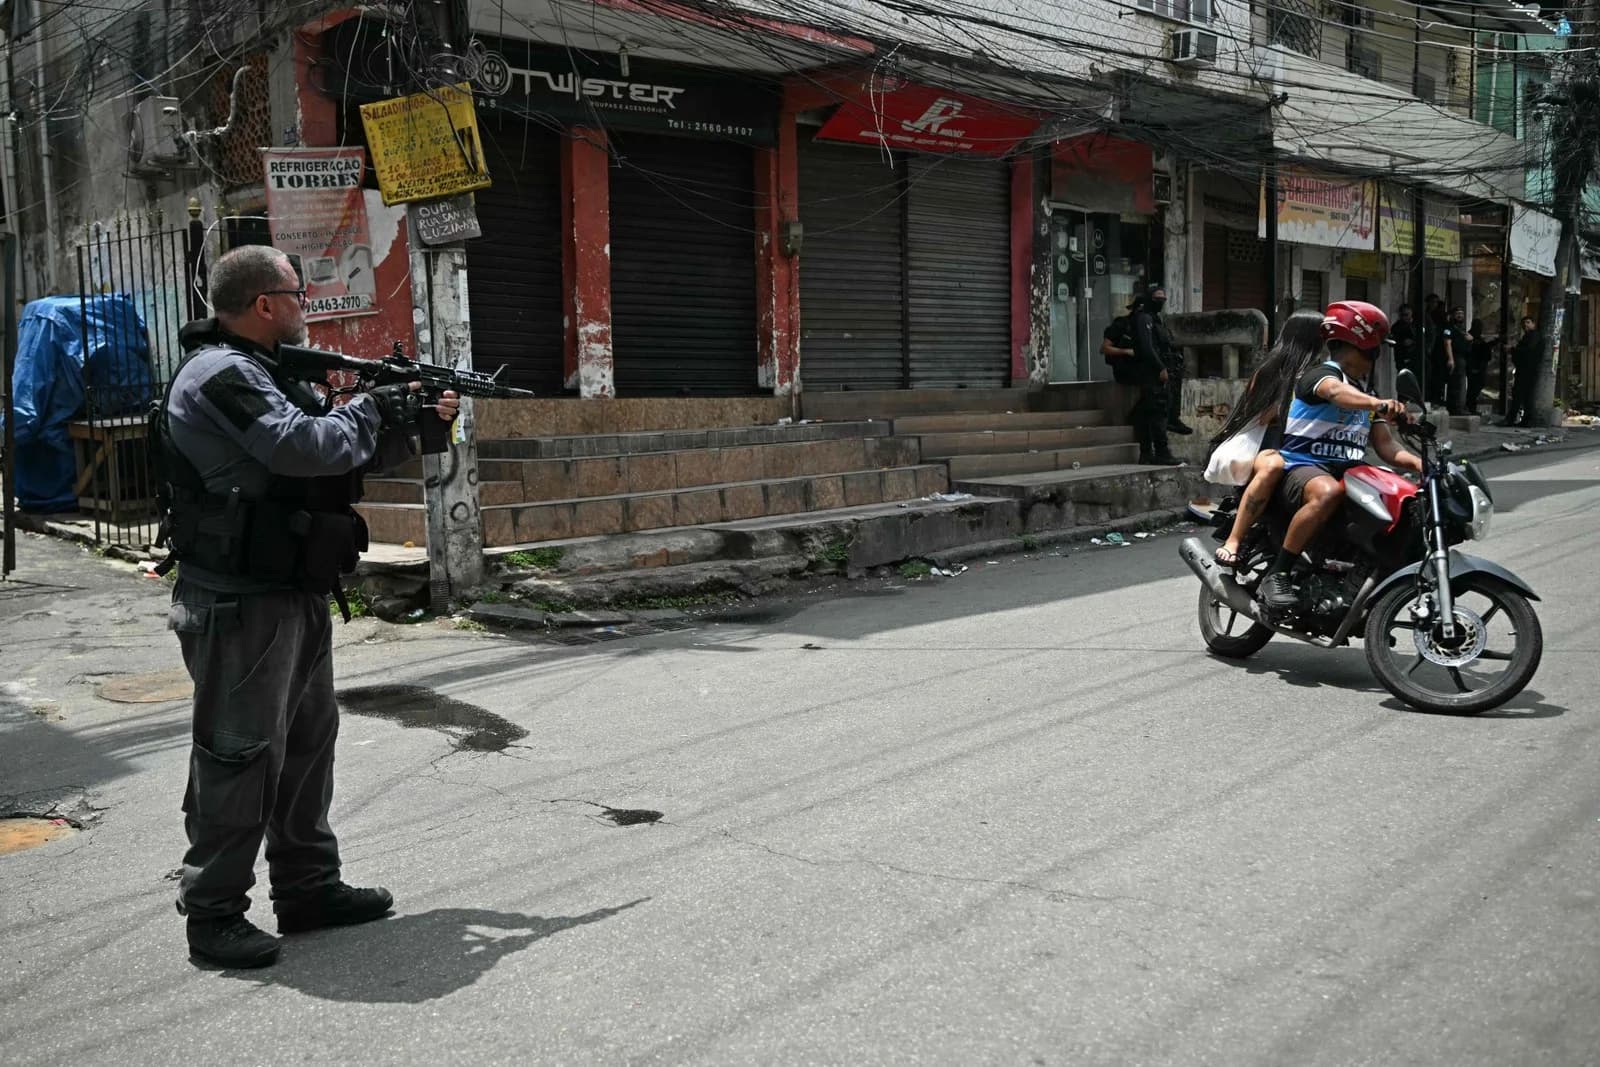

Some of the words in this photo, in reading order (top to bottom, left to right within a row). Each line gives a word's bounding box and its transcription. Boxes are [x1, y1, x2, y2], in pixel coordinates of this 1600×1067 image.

[511, 67, 685, 109] TWISTER
[270, 158, 361, 174] REFRIGERAÇÃO
[271, 172, 360, 189] TORRES
[274, 231, 318, 241] CONSERTO
